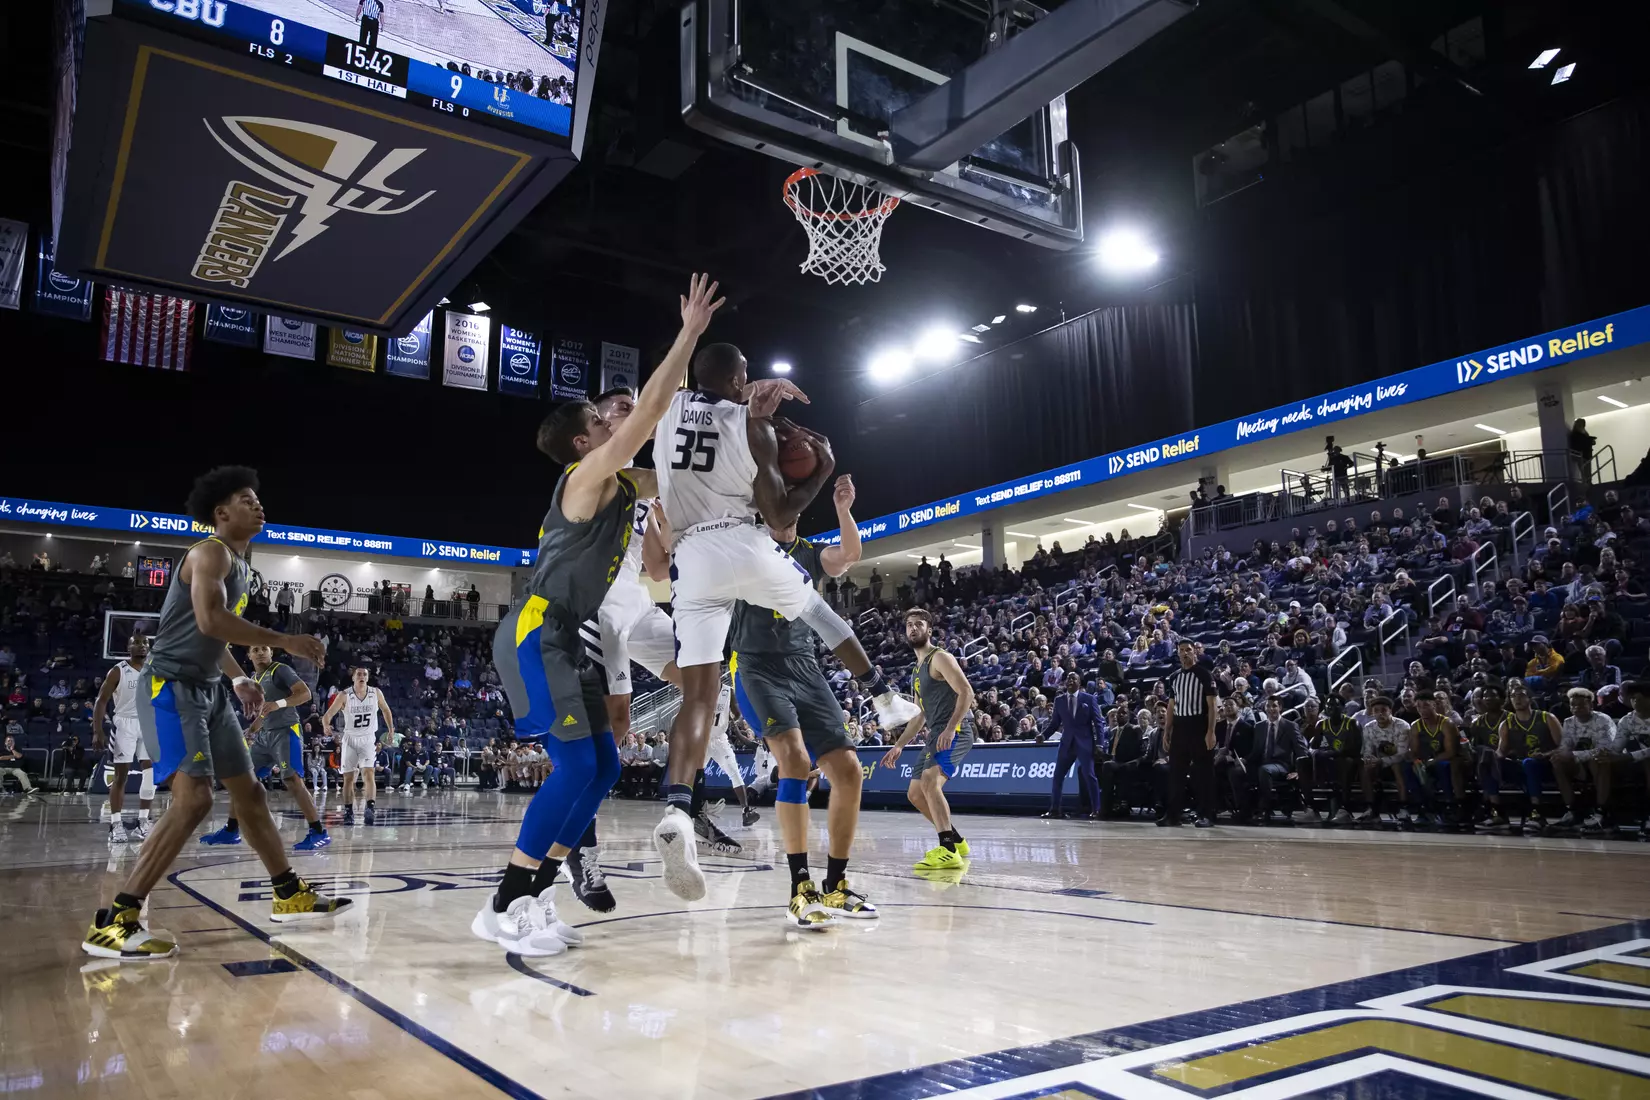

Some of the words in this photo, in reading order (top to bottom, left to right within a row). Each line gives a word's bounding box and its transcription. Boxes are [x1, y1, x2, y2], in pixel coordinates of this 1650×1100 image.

[269, 19, 285, 46] 8
[249, 43, 275, 59] FLS
[285, 53, 293, 65] 2
[345, 42, 393, 77] 15:42
[337, 69, 362, 84] 1ST
[367, 77, 398, 94] HALF
[450, 75, 463, 99] 9
[432, 98, 454, 113] FLS
[462, 107, 470, 117] 0
[191, 180, 298, 289] LANCERS
[36, 290, 89, 305] CHAMPIONS
[208, 319, 255, 333] CHAMPIONS
[455, 318, 480, 330] 2016
[269, 329, 287, 338] WEST
[287, 333, 313, 342] REGION
[447, 334, 487, 346] BASKETBALL
[450, 328, 482, 339] WOMEN'S
[510, 328, 534, 340] 2017
[270, 336, 311, 348] CHAMPIONS
[333, 343, 365, 353] DIVISION
[502, 343, 540, 356] BASKETBALL
[505, 337, 536, 348] WOMEN'S
[560, 339, 584, 350] 2017
[1487, 344, 1544, 374] SEND
[1548, 323, 1615, 358] Relief
[330, 355, 361, 365] RUNNER
[333, 349, 370, 361] NATIONAL
[387, 354, 428, 366] CHAMPIONS
[609, 349, 631, 360] 2017
[445, 369, 486, 380] TOURNAMENT
[451, 364, 475, 373] DIVISION
[500, 374, 539, 386] CHAMPIONS
[682, 409, 713, 426] DAVIS
[1236, 419, 1280, 440] Meeting
[1281, 404, 1314, 425] needs,
[1316, 392, 1373, 417] changing
[1376, 382, 1409, 401] lives
[671, 427, 719, 472] 35
[1126, 447, 1160, 468] SEND
[1162, 435, 1200, 459] Relief
[975, 495, 991, 507] Text
[990, 490, 1014, 502] SEND
[1014, 480, 1044, 496] RELIEF
[1044, 478, 1053, 488] to
[1054, 469, 1081, 486] 888111
[16, 501, 68, 521] changing
[71, 508, 99, 521] lives
[911, 508, 934, 525] SEND
[934, 500, 960, 518] Relief
[151, 517, 188, 531] SEND
[191, 520, 215, 534] Reli
[696, 521, 730, 533] LanceUp
[266, 529, 286, 540] Text
[287, 531, 316, 543] SEND
[317, 534, 351, 546] RELIEF
[352, 538, 363, 547] to
[363, 539, 393, 550] 888111
[438, 544, 468, 558] SEND
[470, 547, 501, 562] Relief
[149, 570, 164, 586] 10
[279, 586, 303, 594] SRVE
[354, 713, 371, 728] 25
[762, 760, 769, 770] 4
[901, 763, 913, 778] Te
[961, 762, 1011, 778] RELIEF
[1011, 764, 1025, 778] to
[1028, 762, 1075, 778] 8881
